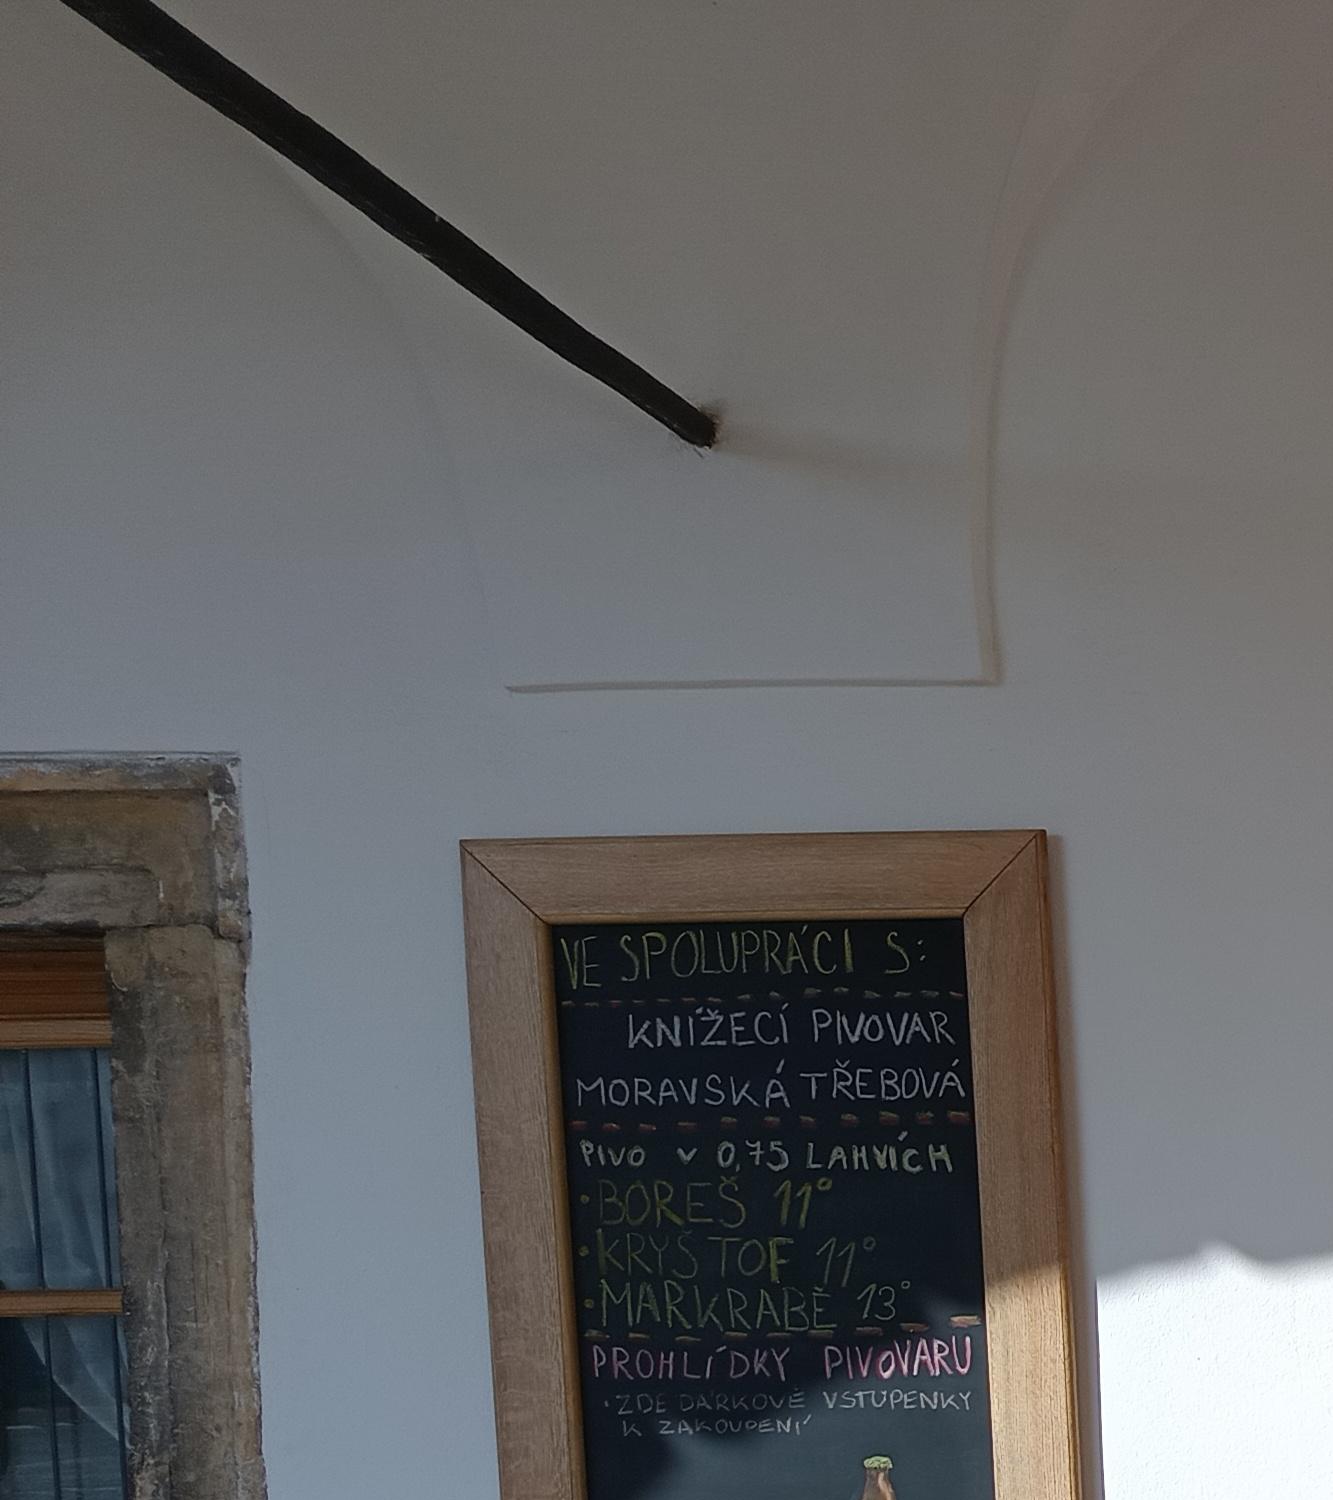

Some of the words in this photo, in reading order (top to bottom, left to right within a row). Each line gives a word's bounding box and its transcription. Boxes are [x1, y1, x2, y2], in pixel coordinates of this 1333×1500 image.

[560, 935, 602, 990] VE
[620, 924, 854, 982] SPOLUPRÁCI
[627, 1002, 791, 1048] KNÍŽECÍ
[811, 1007, 957, 1046] PIVOVAR
[576, 1059, 792, 1109] MORAVSKÁ
[800, 1059, 966, 1101] TŘEBOVÁ
[580, 1139, 647, 1168] PIVO
[716, 1140, 791, 1173] 0,75
[600, 1175, 748, 1230] BOREŠ
[600, 1279, 838, 1332] MARKRABĚ
[592, 1345, 791, 1382] PROHLÍDKY
[825, 1335, 972, 1381] PIVOVARU
[616, 1394, 667, 1416] ZDE
[679, 1387, 806, 1414] DÁRKOVÉ
[822, 1389, 972, 1413] VSTUPENKY
[622, 1420, 642, 1437] K
